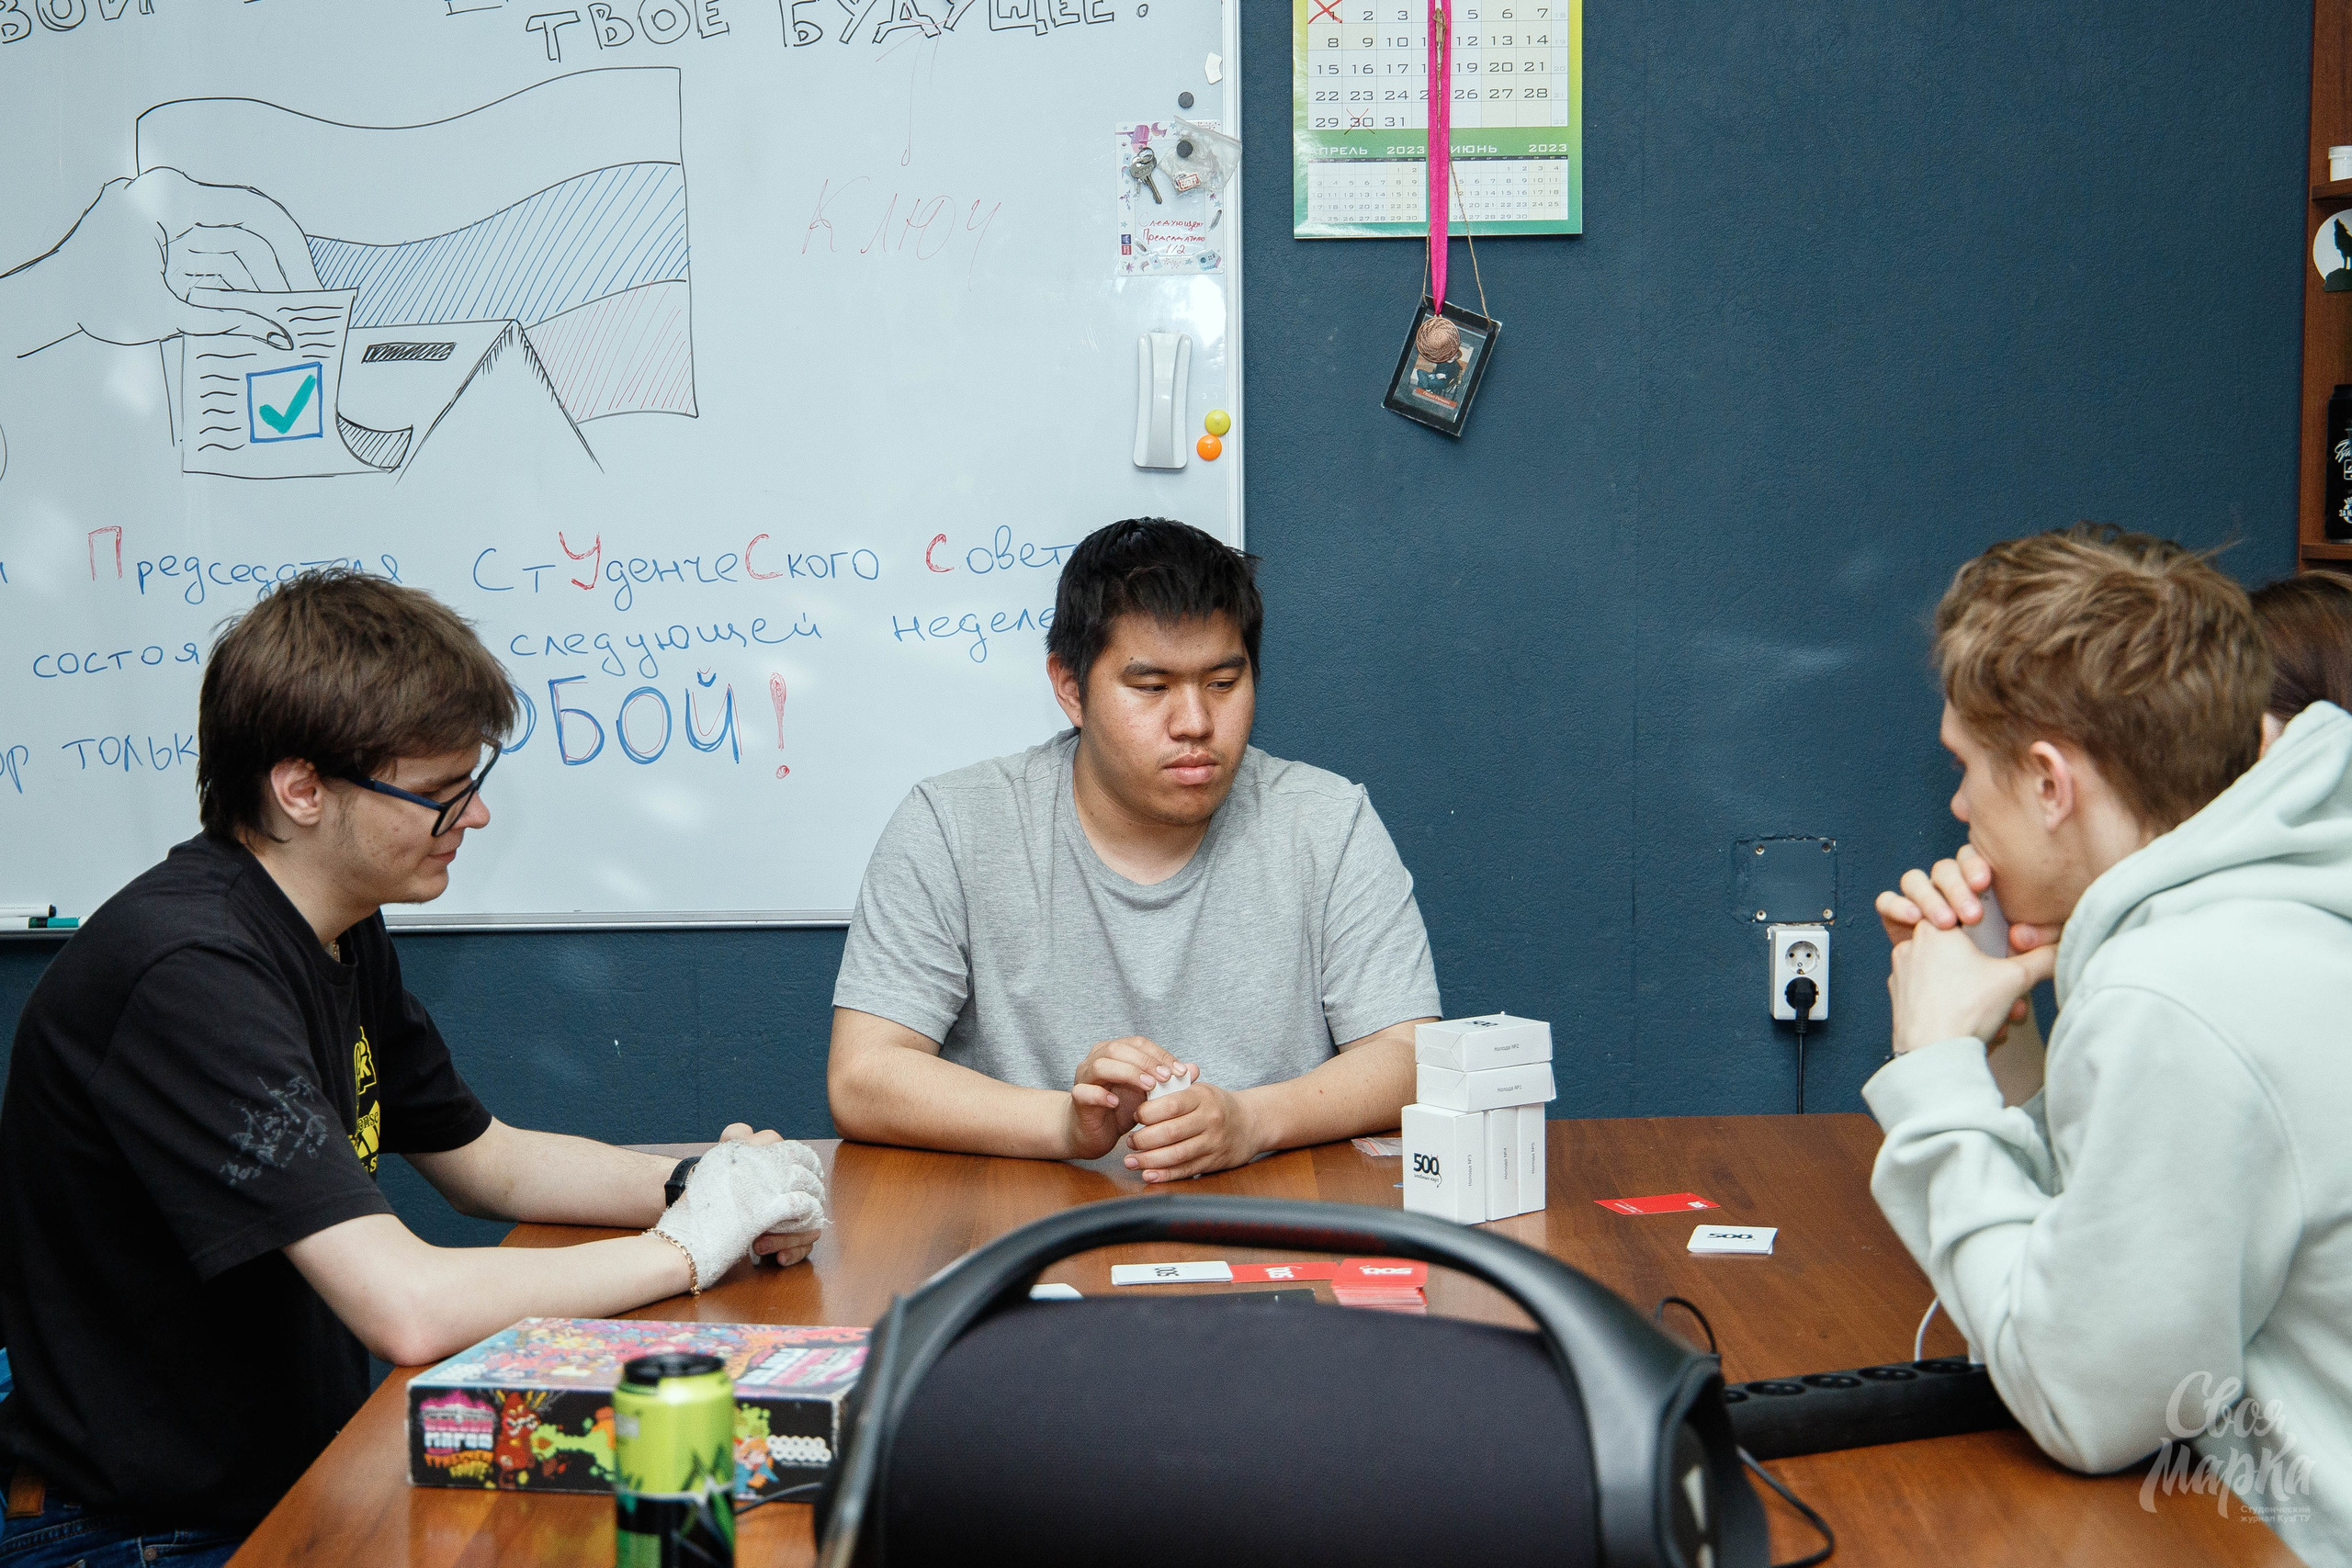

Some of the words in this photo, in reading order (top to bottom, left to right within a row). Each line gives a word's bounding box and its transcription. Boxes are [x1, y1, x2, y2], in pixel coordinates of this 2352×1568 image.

[1363, 11, 1373, 21] 2
[1398, 10, 1408, 20] 3
[1468, 10, 1478, 19] 5
[1502, 9, 1513, 19] 6
[1537, 8, 1548, 18] 7
[526, 0, 730, 62] ТВОЕ
[1328, 38, 1339, 48] 8
[1363, 38, 1373, 47] 9
[1387, 37, 1408, 47] 10
[1457, 36, 1478, 46] 12
[1492, 36, 1513, 45] 13
[1526, 35, 1548, 45] 14
[1317, 65, 1339, 74] 15
[1352, 64, 1373, 74] 16
[1387, 64, 1408, 74] 17
[1457, 63, 1478, 73] 19
[1489, 62, 1513, 72] 20
[1524, 62, 1544, 71] 21
[1316, 91, 1339, 101] 22
[1350, 91, 1373, 101] 23
[1385, 90, 1409, 100] 24
[1454, 89, 1478, 99] 26
[1489, 89, 1513, 99] 27
[1524, 88, 1548, 98] 28
[1316, 118, 1339, 127] 29
[1350, 117, 1374, 127] 30
[1385, 117, 1405, 127] 31
[1387, 146, 1425, 155] 2023
[1451, 145, 1497, 153] ИЮНЬ
[1528, 144, 1567, 152] 2023
[1165, 243, 1185, 254] 1/2
[511, 613, 822, 678] следующей
[1413, 1152, 1440, 1176] 500
